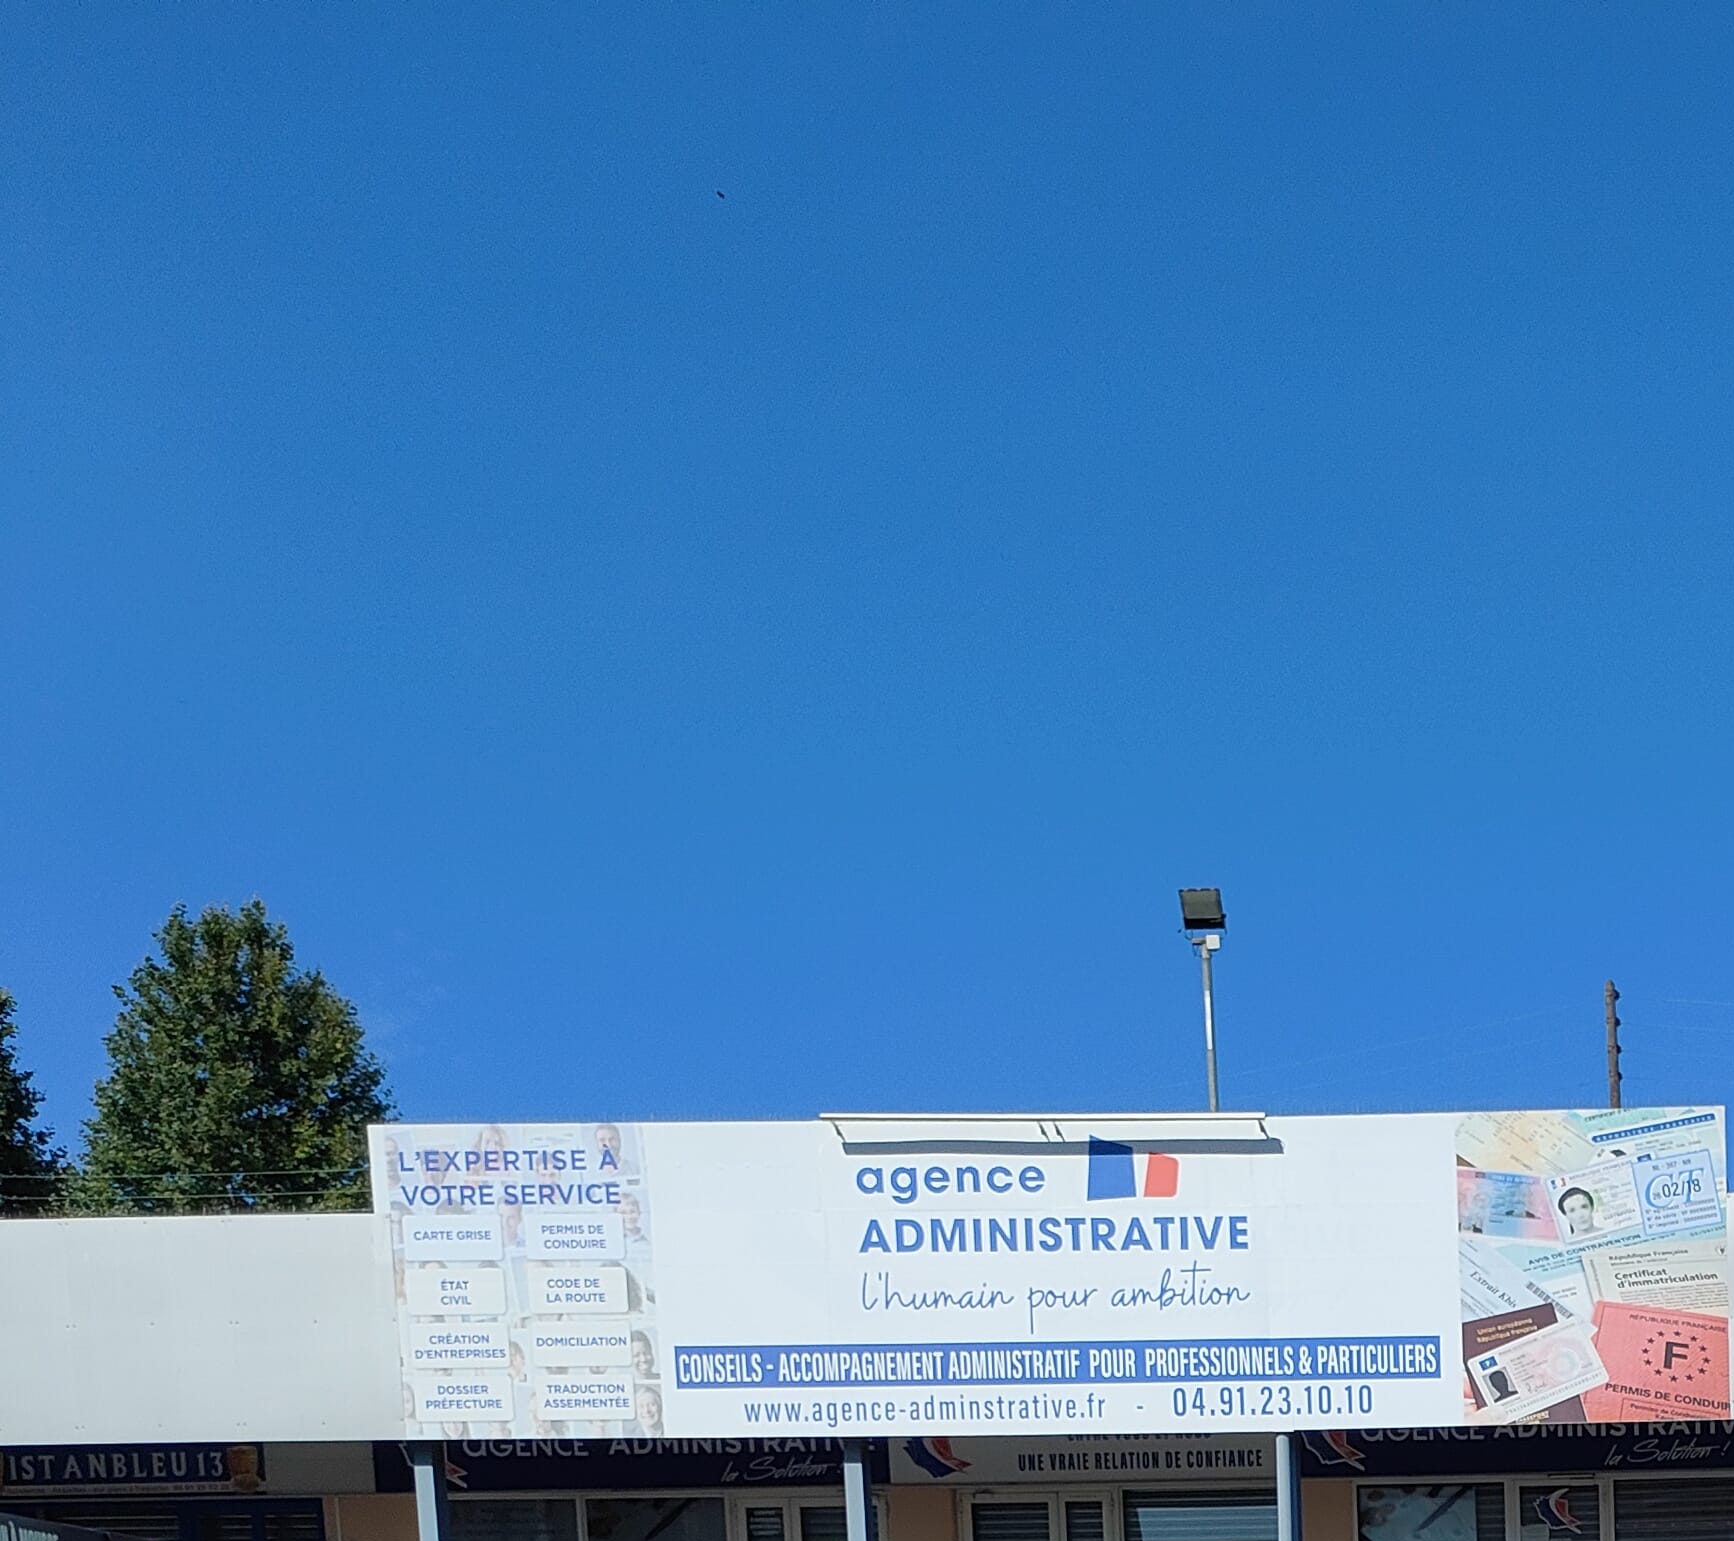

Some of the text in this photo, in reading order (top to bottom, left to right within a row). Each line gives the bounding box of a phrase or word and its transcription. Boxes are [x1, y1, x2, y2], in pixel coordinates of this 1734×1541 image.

[599, 1143, 619, 1170] À
[856, 1165, 1046, 1205] agence
[1662, 1178, 1702, 1199] 02/18
[401, 1183, 622, 1207] VOTRE SERVICE
[413, 1229, 492, 1242] CARTE GRISE
[541, 1224, 604, 1235] PERMIS DE
[859, 1216, 1249, 1253] ADMINISTRATIVE
[543, 1239, 607, 1250] CONDUIRE
[1528, 1255, 1550, 1266] AVIS
[1551, 1251, 1564, 1260] DE
[1566, 1233, 1642, 1256] CONTRAVENTION
[1614, 1267, 1668, 1281] Certificat
[440, 1279, 470, 1291] ÉTAT
[547, 1278, 601, 1289] CODE DE
[440, 1295, 472, 1306] CIVIL
[546, 1293, 607, 1303] LA ROUTE
[1027, 1286, 1098, 1335] pour
[1111, 1260, 1250, 1311] ambition
[429, 1333, 490, 1345] CRÉATION
[536, 1336, 628, 1347] DOMICILIATION
[1663, 1341, 1690, 1370] F
[678, 1353, 763, 1385] CONSEILS
[778, 1350, 944, 1383] ACCOMPAGNEMENT
[948, 1348, 1081, 1381] ADMINISTRATIF
[1088, 1348, 1137, 1378] POUR
[1144, 1346, 1295, 1377] PROFESSIONNELS
[1299, 1346, 1314, 1376] &
[1317, 1344, 1437, 1375] PARTICULIERS
[437, 1385, 489, 1396] DOSSIER
[547, 1384, 626, 1394] TRADUCTION
[1605, 1382, 1652, 1399] PERMIS
[1654, 1391, 1671, 1401] DE
[425, 1397, 503, 1410] PRÉFECTURE
[544, 1396, 631, 1409] ASSERMENTÉE
[1173, 1384, 1373, 1417] 04.91.23.10.10
[1017, 1448, 1264, 1472] UNE VRAIE RELATION DE CONFIANCE
[1605, 1443, 1619, 1466] la
[1626, 1438, 1718, 1464] Solution
[197, 1451, 224, 1477] 13
